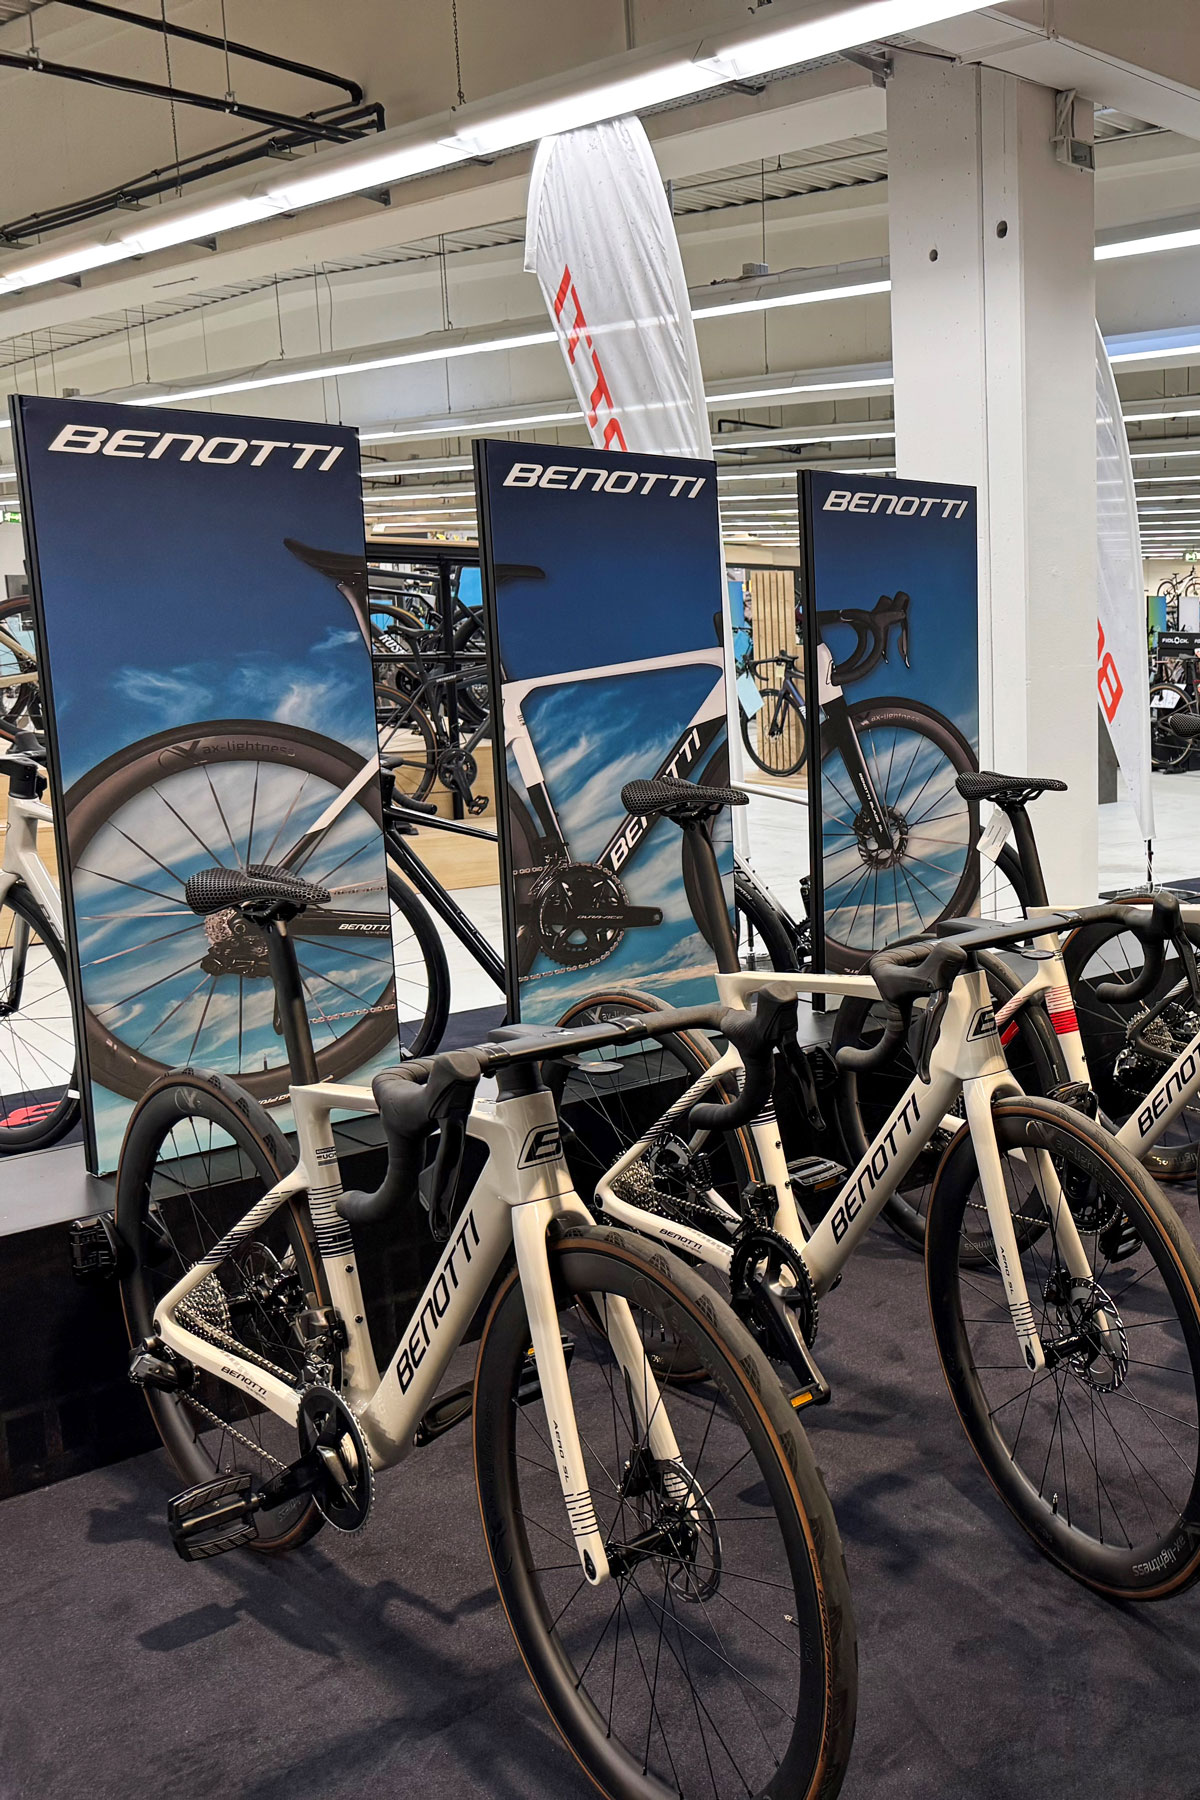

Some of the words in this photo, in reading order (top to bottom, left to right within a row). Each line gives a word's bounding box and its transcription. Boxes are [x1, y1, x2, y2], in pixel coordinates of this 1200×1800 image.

[47, 424, 344, 471] BENOTTI
[503, 463, 706, 498] BENOTTI
[822, 490, 968, 519] BENOTTI
[203, 741, 296, 757] ax-lightness
[611, 728, 701, 871] BETTI
[832, 1091, 921, 1244] BENOTTI
[659, 1228, 703, 1250] BENOTTI
[398, 1209, 480, 1394] BENOTTI
[221, 1366, 267, 1395] BENOTTI
[553, 1420, 565, 1459] AERO
[1132, 1535, 1187, 1577] ax-lightness
